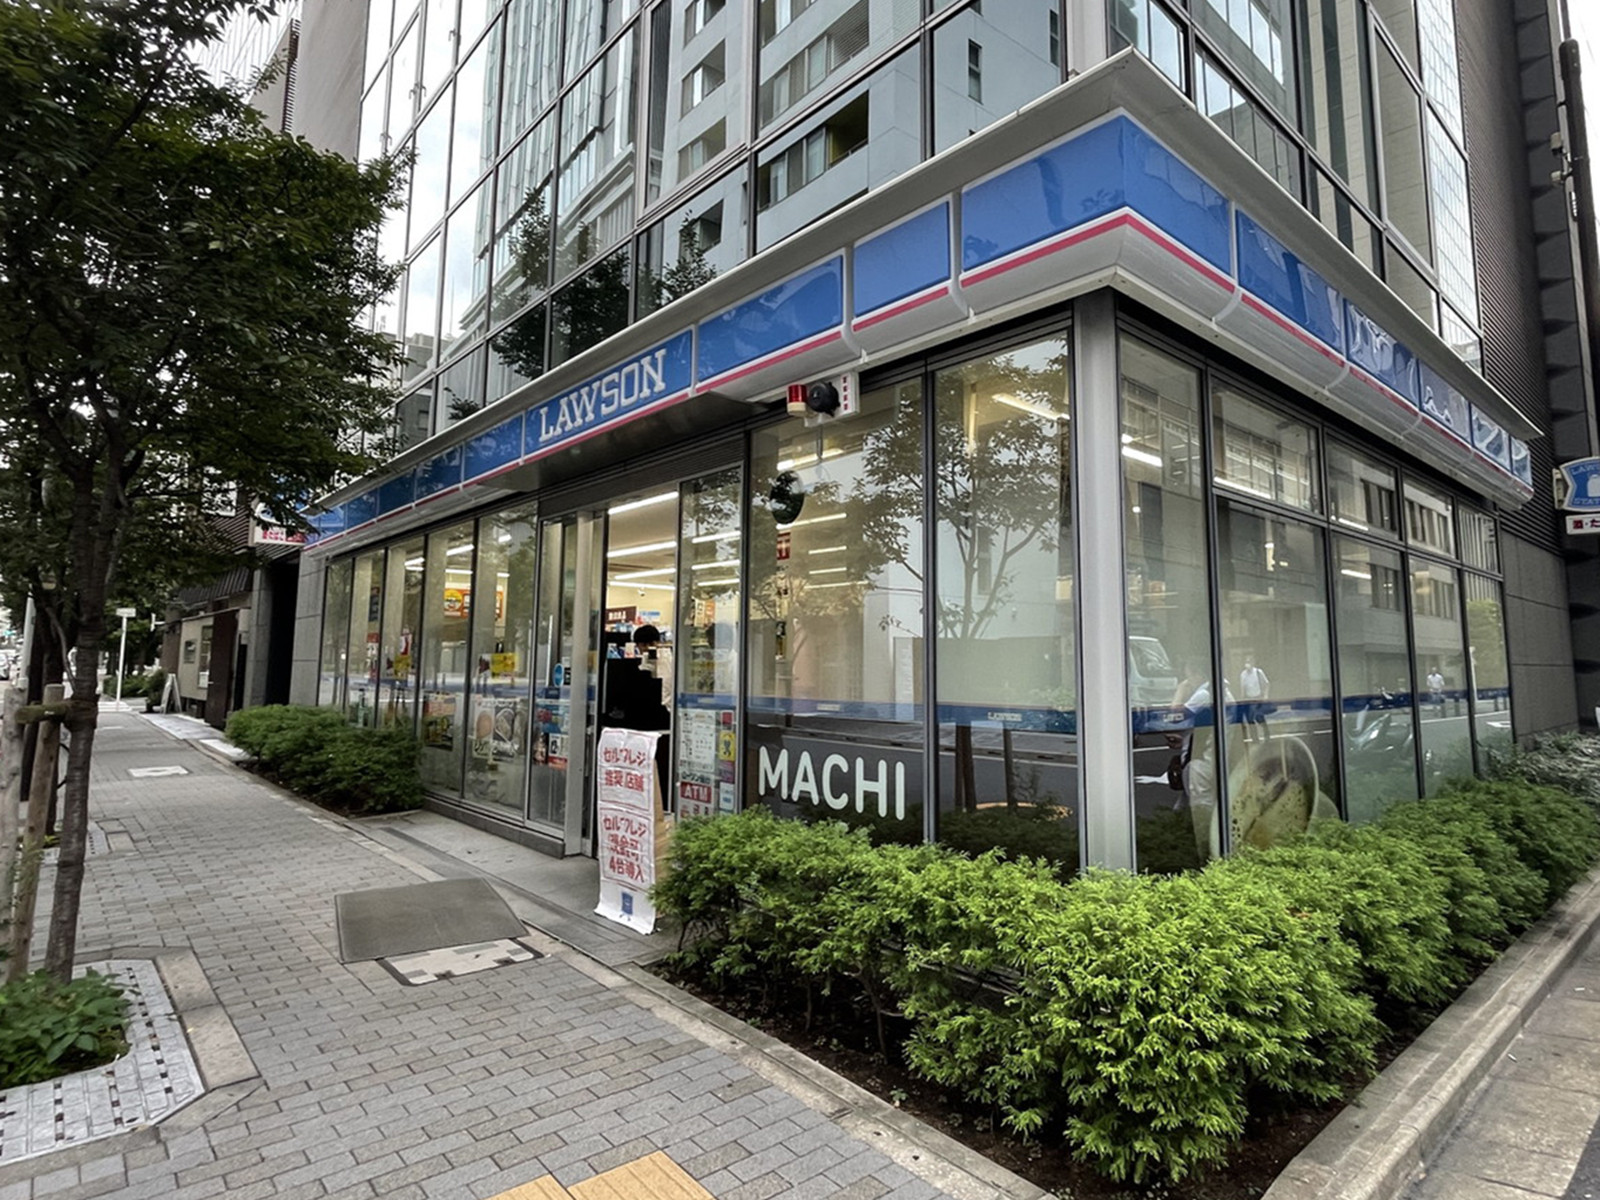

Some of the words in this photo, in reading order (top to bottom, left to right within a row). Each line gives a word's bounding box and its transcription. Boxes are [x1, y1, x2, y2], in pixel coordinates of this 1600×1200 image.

[538, 348, 667, 443] LAWSON
[603, 747, 646, 766] セルフレジ
[684, 784, 708, 801] ATM
[758, 746, 906, 822] MACHI
[603, 815, 647, 838] セルフレジ
